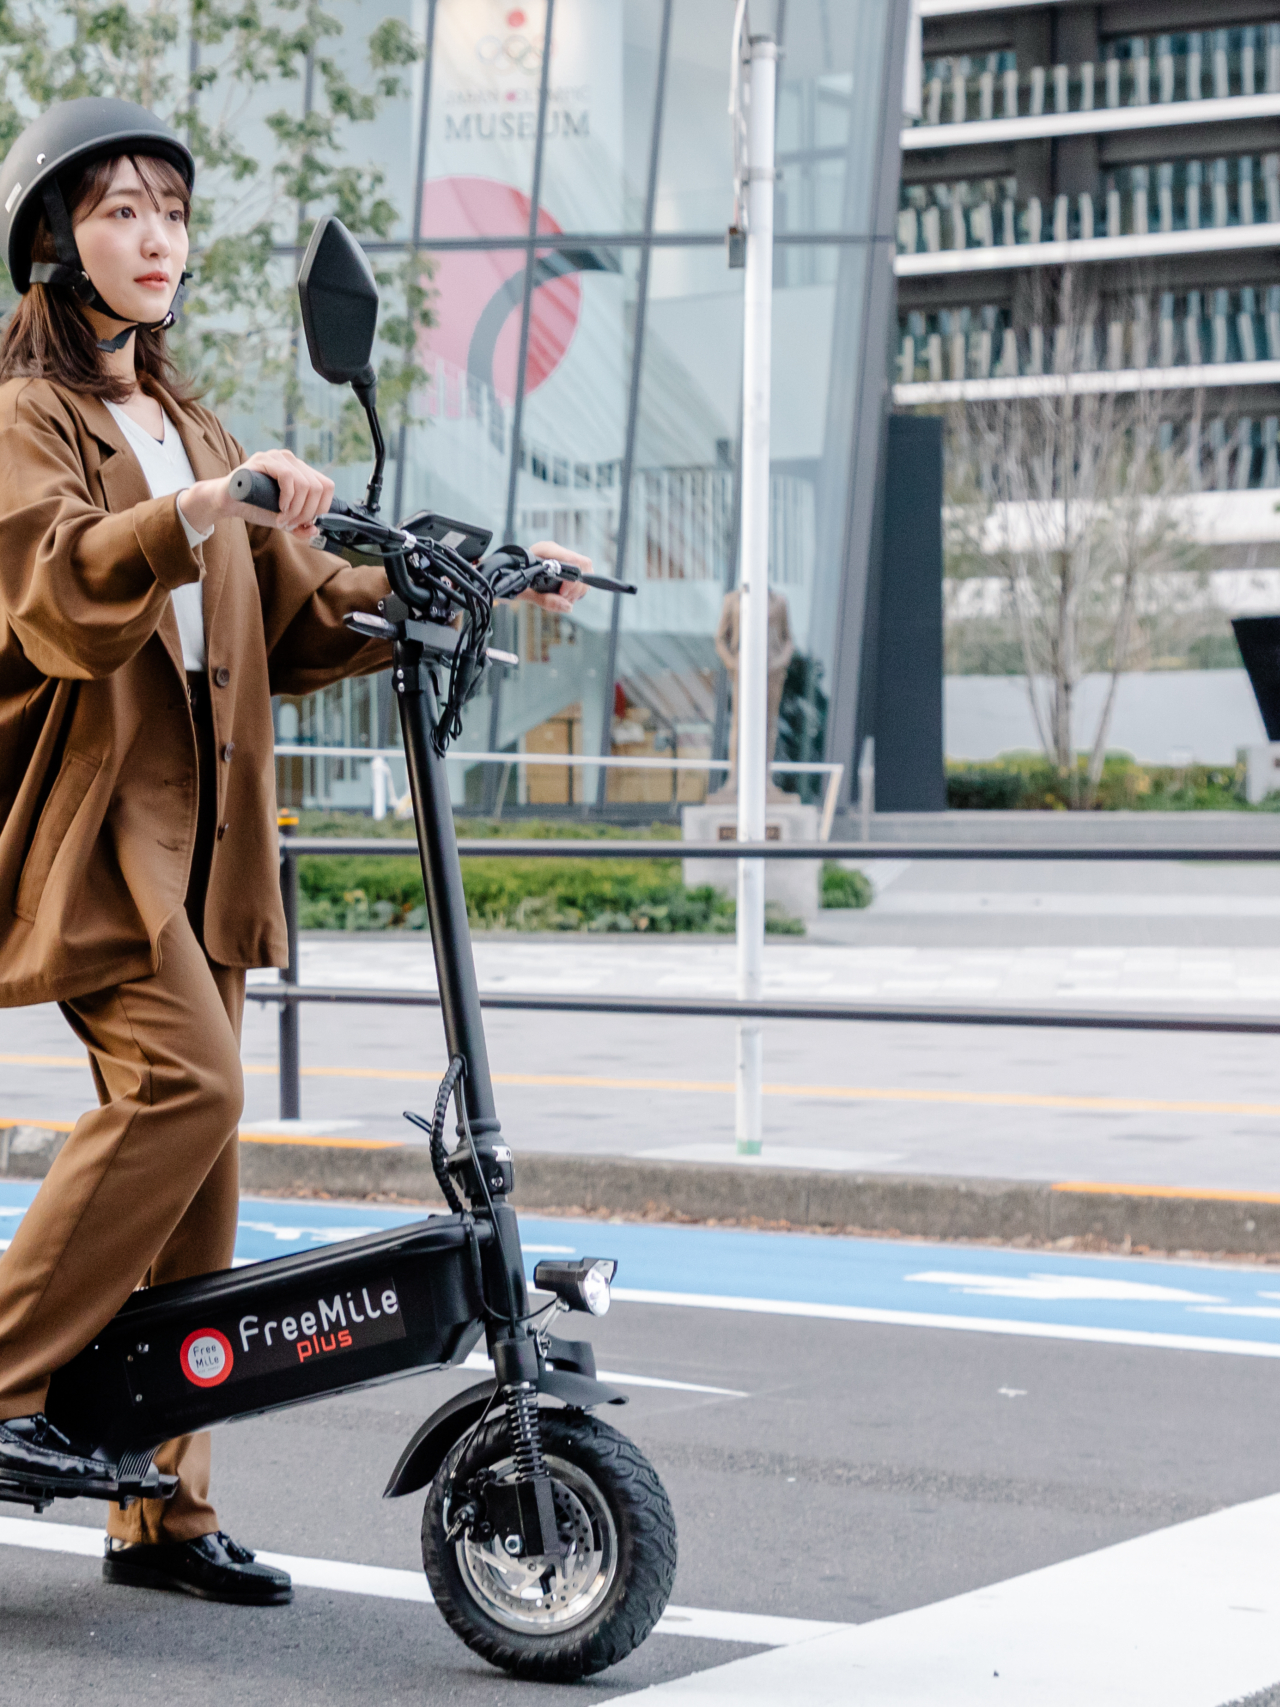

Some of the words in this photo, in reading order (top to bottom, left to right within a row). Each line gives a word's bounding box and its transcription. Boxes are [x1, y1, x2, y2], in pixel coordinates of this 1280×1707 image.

[445, 109, 590, 141] MUSEUM
[239, 1287, 399, 1352] FreeMile
[193, 1345, 217, 1357] Free
[196, 1356, 219, 1368] Mile
[296, 1329, 353, 1363] plus
